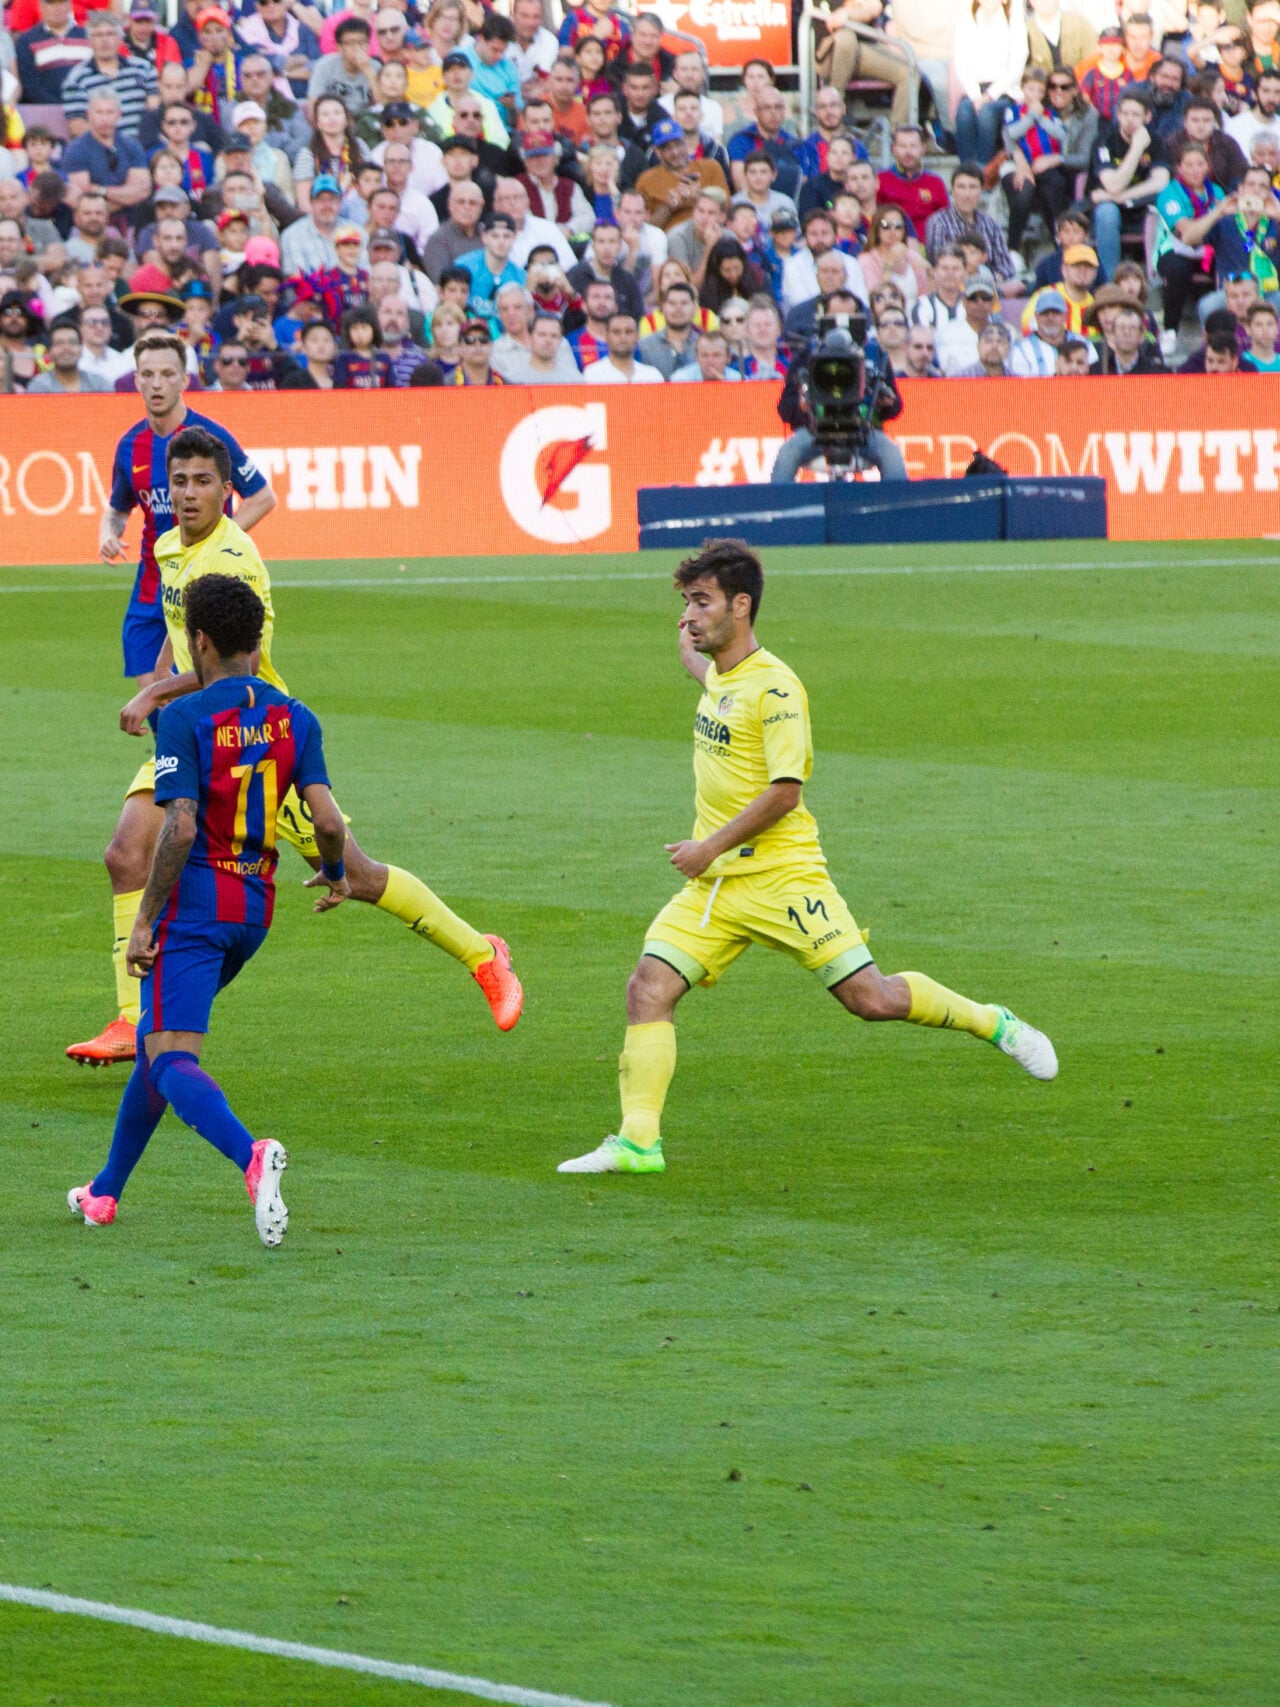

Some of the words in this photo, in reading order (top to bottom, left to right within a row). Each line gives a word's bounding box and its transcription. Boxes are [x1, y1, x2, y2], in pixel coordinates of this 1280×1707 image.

[499, 402, 612, 545] G
[216, 724, 275, 748] NEYMAR
[155, 754, 179, 771] eko
[788, 895, 829, 935] 14
